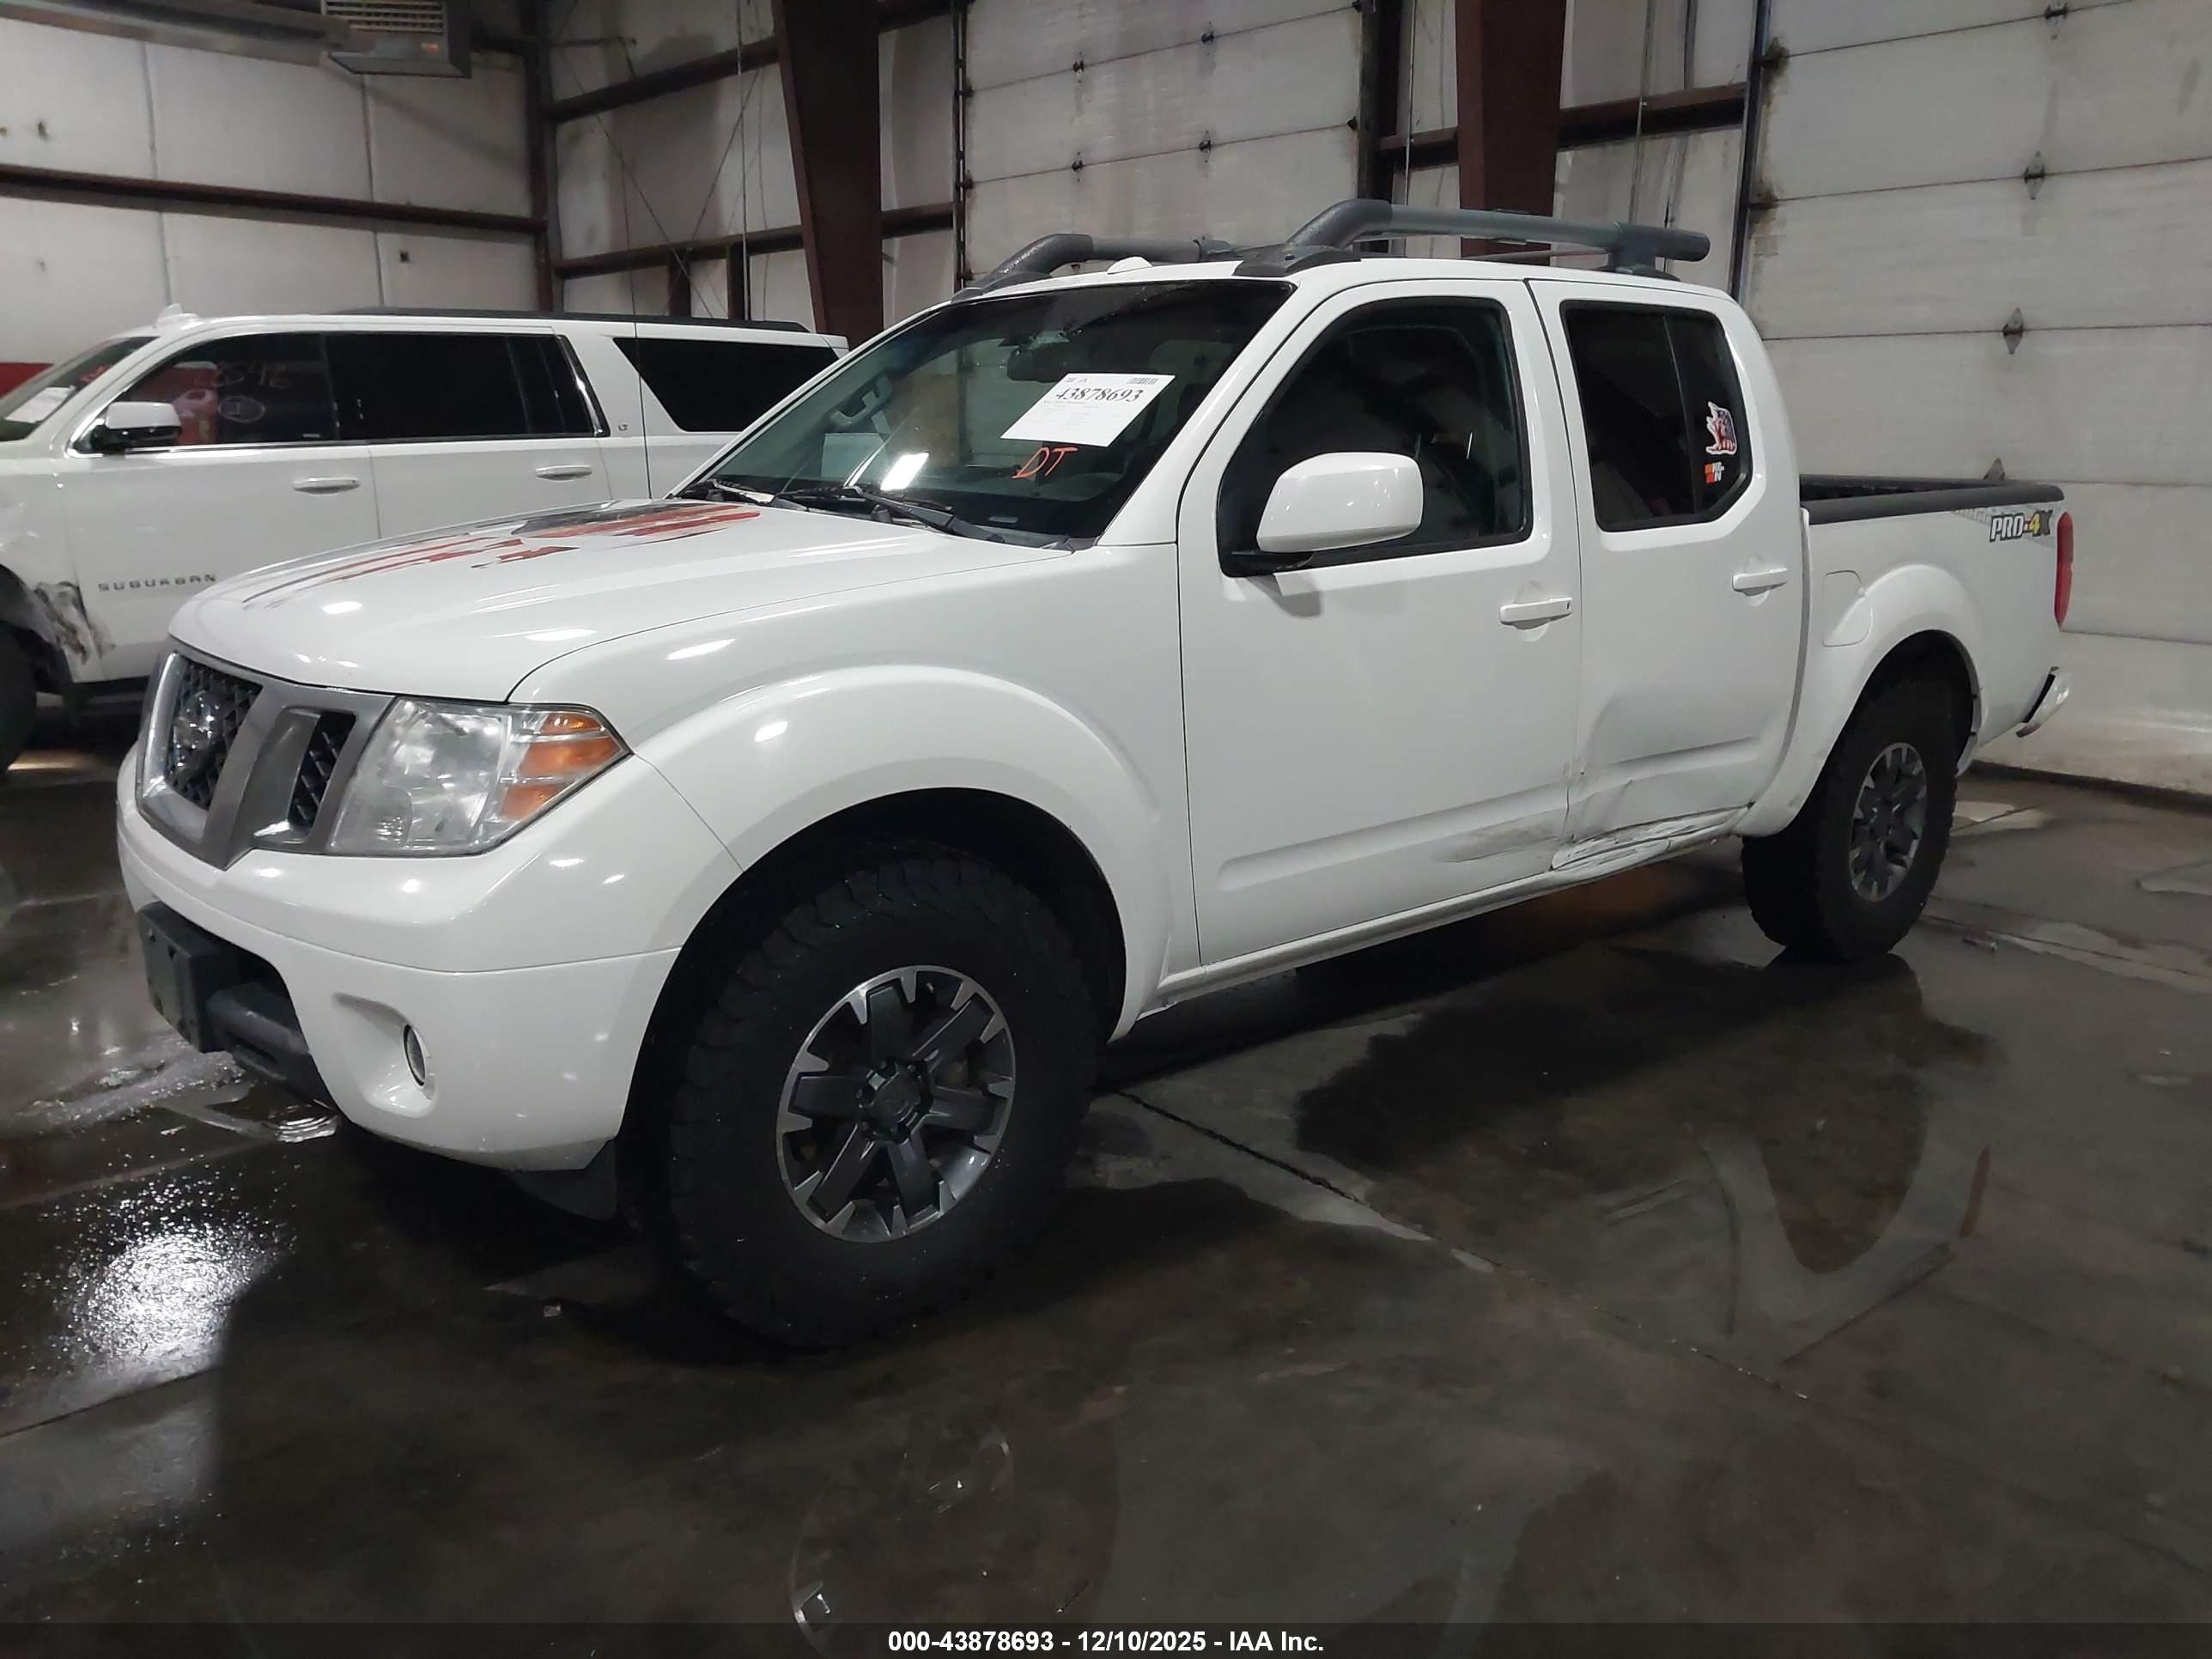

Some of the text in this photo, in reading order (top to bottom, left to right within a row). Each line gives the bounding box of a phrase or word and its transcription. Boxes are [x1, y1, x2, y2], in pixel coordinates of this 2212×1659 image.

[1055, 387, 1144, 403] 43878693
[1011, 447, 1079, 479] DT
[1989, 509, 2053, 543] PRO-4X
[98, 574, 216, 592] SUBURBAN
